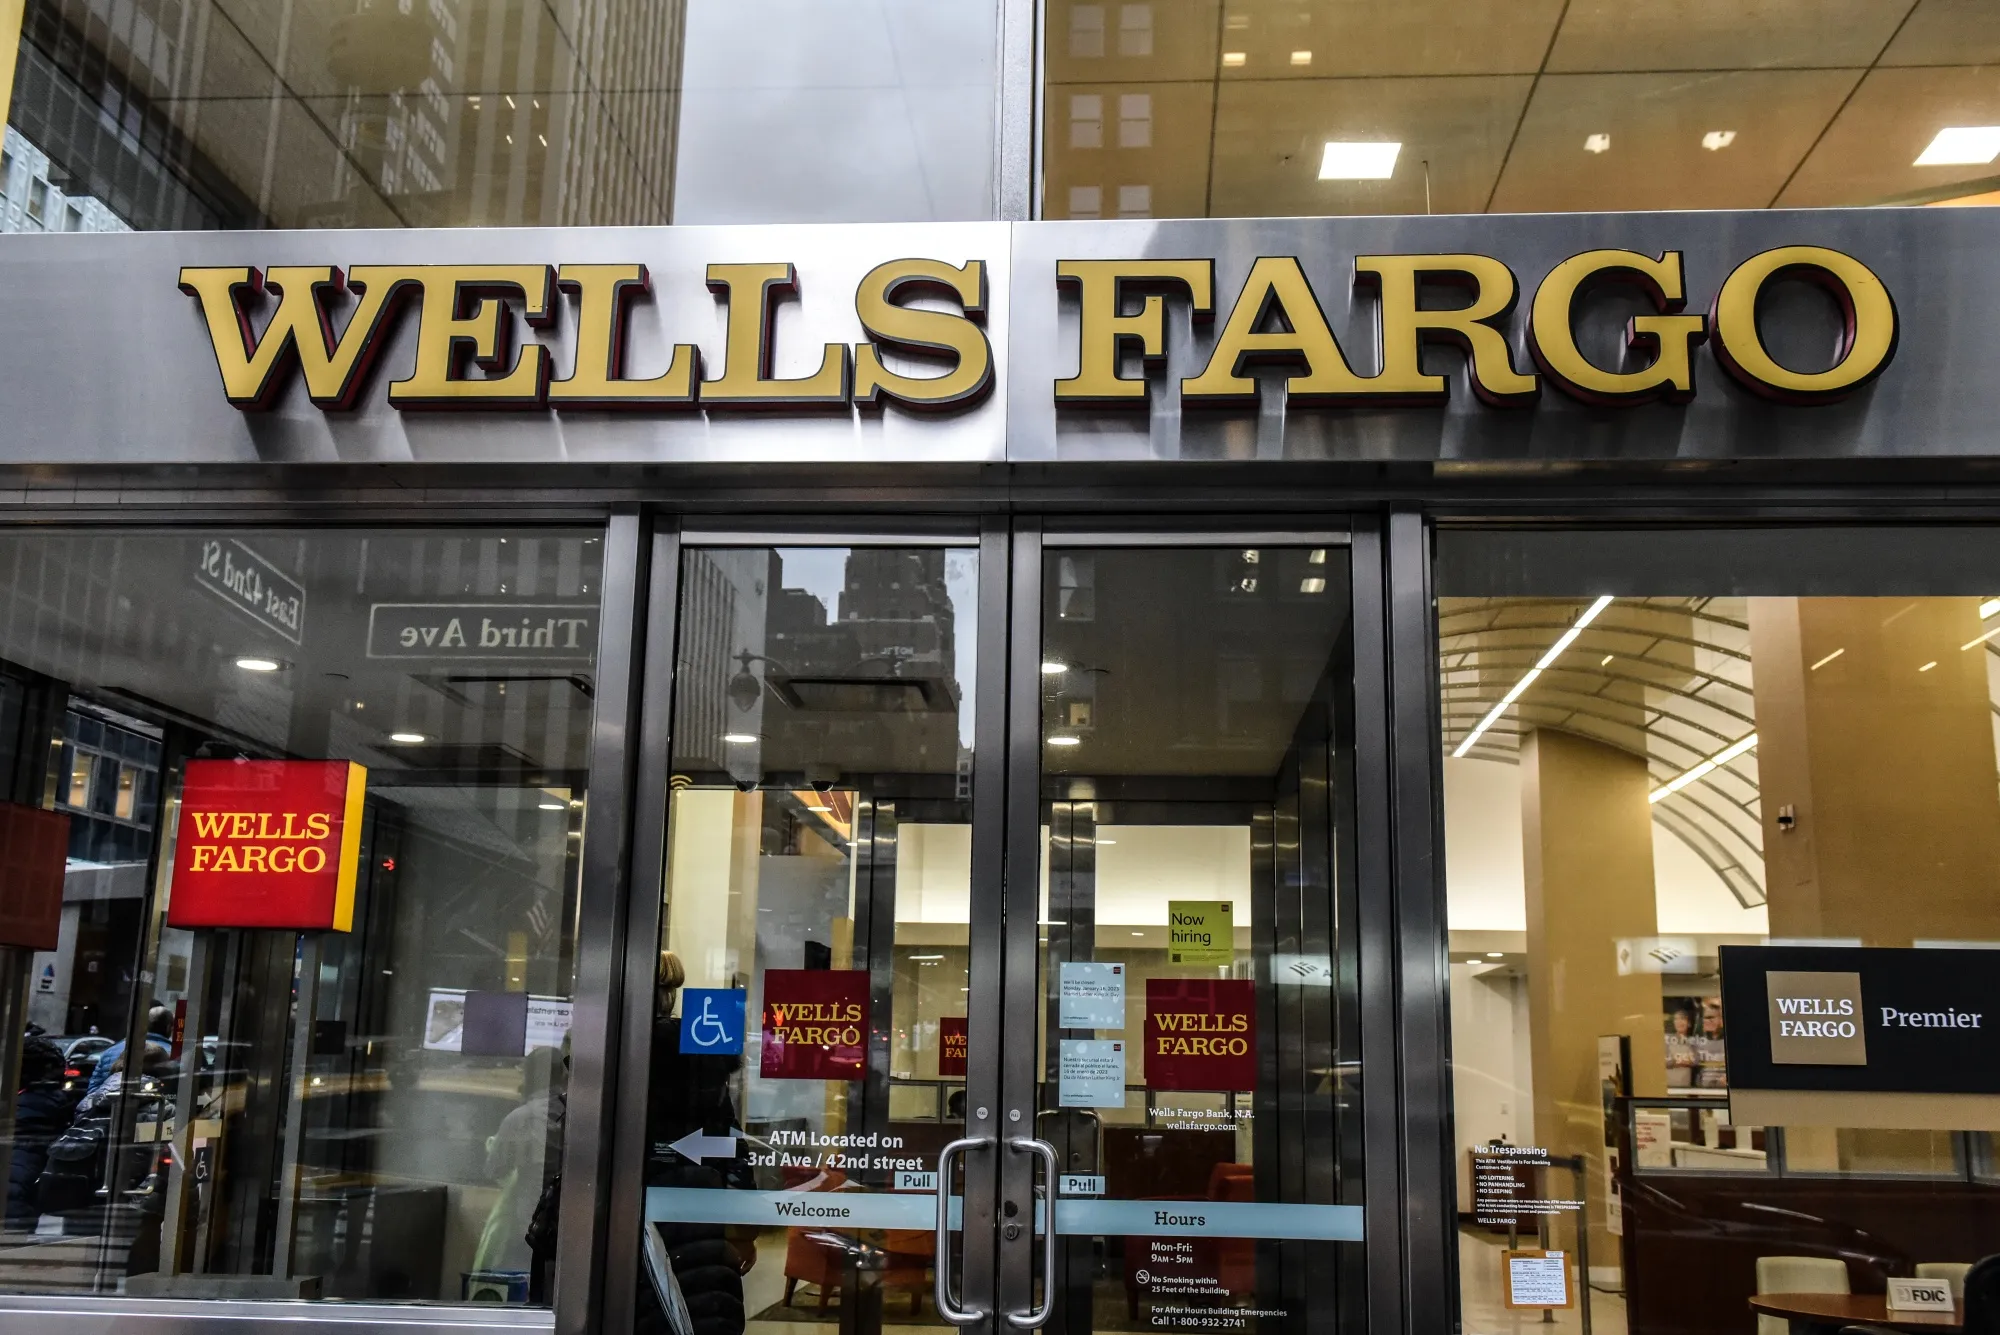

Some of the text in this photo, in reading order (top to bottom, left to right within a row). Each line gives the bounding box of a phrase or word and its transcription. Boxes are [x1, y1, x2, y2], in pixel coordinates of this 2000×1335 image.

[177, 245, 1900, 413] WELLS FARGO
[192, 812, 330, 839] WELLS
[189, 845, 326, 873] FARGO
[1171, 912, 1205, 925] Now
[1171, 929, 1211, 946] hiring
[771, 1003, 862, 1022] WELLS
[1776, 998, 1854, 1016] WELLS
[1154, 1013, 1248, 1032] WELLS
[1880, 1007, 1983, 1028] Premier
[772, 1026, 860, 1046] FARGO
[1779, 1020, 1856, 1038] FARGO
[1156, 1037, 1248, 1056] FARGO
[1149, 1107, 1255, 1119] Wells Fargo Bank, N.A.
[1166, 1121, 1237, 1131] wellsfargo.com
[769, 1131, 903, 1149] ATM Located on
[1474, 1145, 1547, 1157] No Trespassing
[747, 1152, 923, 1171] 3rd Ave / 42nd street
[903, 1174, 931, 1188] Pull
[1069, 1178, 1096, 1192] Pull
[775, 1201, 850, 1218] Welcome
[1154, 1211, 1206, 1226] Hours
[1151, 1242, 1193, 1252] Mon-Fri:
[1151, 1253, 1169, 1263] 9AM
[1176, 1254, 1193, 1263] 5PM
[1163, 1276, 1194, 1285] Smoking
[1200, 1287, 1230, 1296] Building
[1912, 1289, 1946, 1302] FDIC
[1165, 1306, 1184, 1314] After
[1208, 1307, 1239, 1317] Building
[1241, 1308, 1287, 1317] Emergencies
[1151, 1316, 1246, 1328] Call 1-800-932-2741
